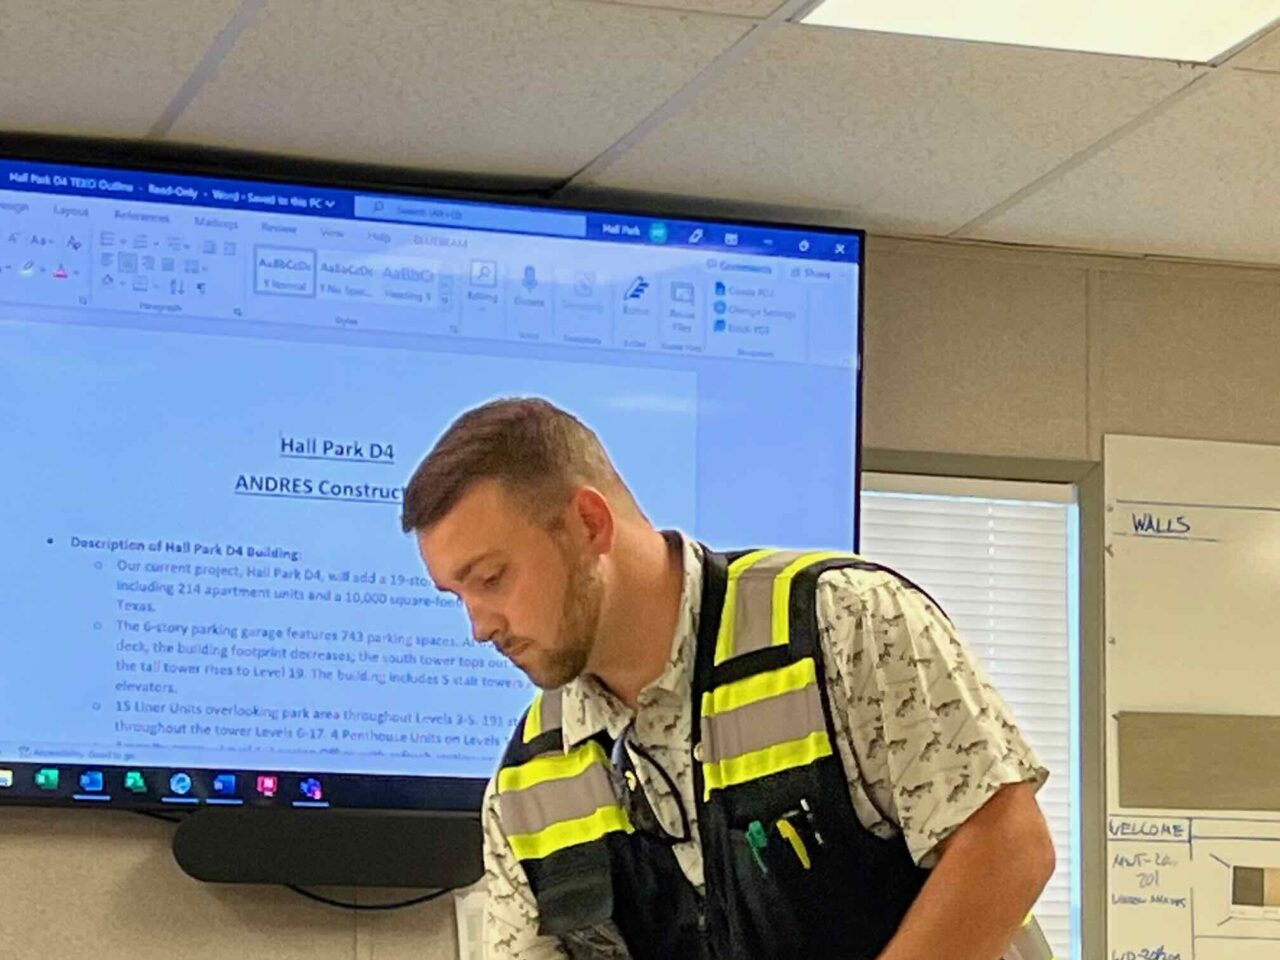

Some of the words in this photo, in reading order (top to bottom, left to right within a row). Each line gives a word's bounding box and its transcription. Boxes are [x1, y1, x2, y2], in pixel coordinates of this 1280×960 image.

[280, 437, 317, 455] Hall
[322, 439, 364, 458] Park
[369, 443, 395, 460] D4
[235, 474, 314, 495] ANDRES
[1132, 513, 1192, 534] WALLS
[71, 536, 145, 552] Description
[148, 540, 163, 551] of
[165, 542, 191, 553] Hall
[194, 543, 222, 556] Park
[225, 545, 243, 556] D4
[247, 547, 303, 562] Building:
[117, 559, 140, 571] Our
[145, 562, 191, 574] current
[194, 565, 243, 578] project,
[246, 567, 270, 578] Hall
[274, 568, 300, 580] Park
[328, 571, 349, 582] will
[353, 572, 376, 584] add
[117, 580, 174, 596] including
[178, 582, 201, 595] 214
[204, 584, 270, 601] apartment
[274, 588, 304, 601] units
[308, 590, 331, 601] and
[117, 599, 156, 613] Texas.
[116, 619, 139, 632] The
[144, 621, 188, 636] 6-story
[191, 624, 238, 639] parking
[241, 627, 283, 641] garage
[286, 626, 337, 641] features
[341, 630, 364, 643] 743
[367, 632, 413, 647] parking
[116, 639, 150, 654] deck,
[153, 641, 174, 653] the
[177, 642, 229, 659] building
[231, 644, 287, 660] footprint
[290, 649, 356, 664] decreases,
[359, 650, 379, 662] the
[382, 652, 416, 665] south
[420, 654, 455, 667] tower
[459, 657, 485, 670] tops
[116, 660, 137, 672] the
[164, 661, 200, 674] tower
[236, 666, 250, 677] to
[253, 666, 286, 679] Level
[311, 668, 333, 681] The
[337, 670, 386, 685] building
[389, 672, 438, 685] includes
[115, 681, 178, 695] elevators.
[115, 701, 131, 712] 15
[170, 704, 201, 715] Units
[205, 704, 280, 720] overlooking
[282, 706, 310, 721] park
[313, 710, 340, 720] area
[343, 709, 412, 725] throughout
[416, 713, 453, 725] Levels
[115, 720, 187, 736] throughout
[191, 722, 211, 735] the
[215, 725, 251, 737] tower
[255, 726, 293, 739] Levels
[342, 730, 407, 744] Penthouse
[410, 732, 441, 745] Units
[464, 734, 500, 747] Levels
[1108, 819, 1184, 837] WELCOME
